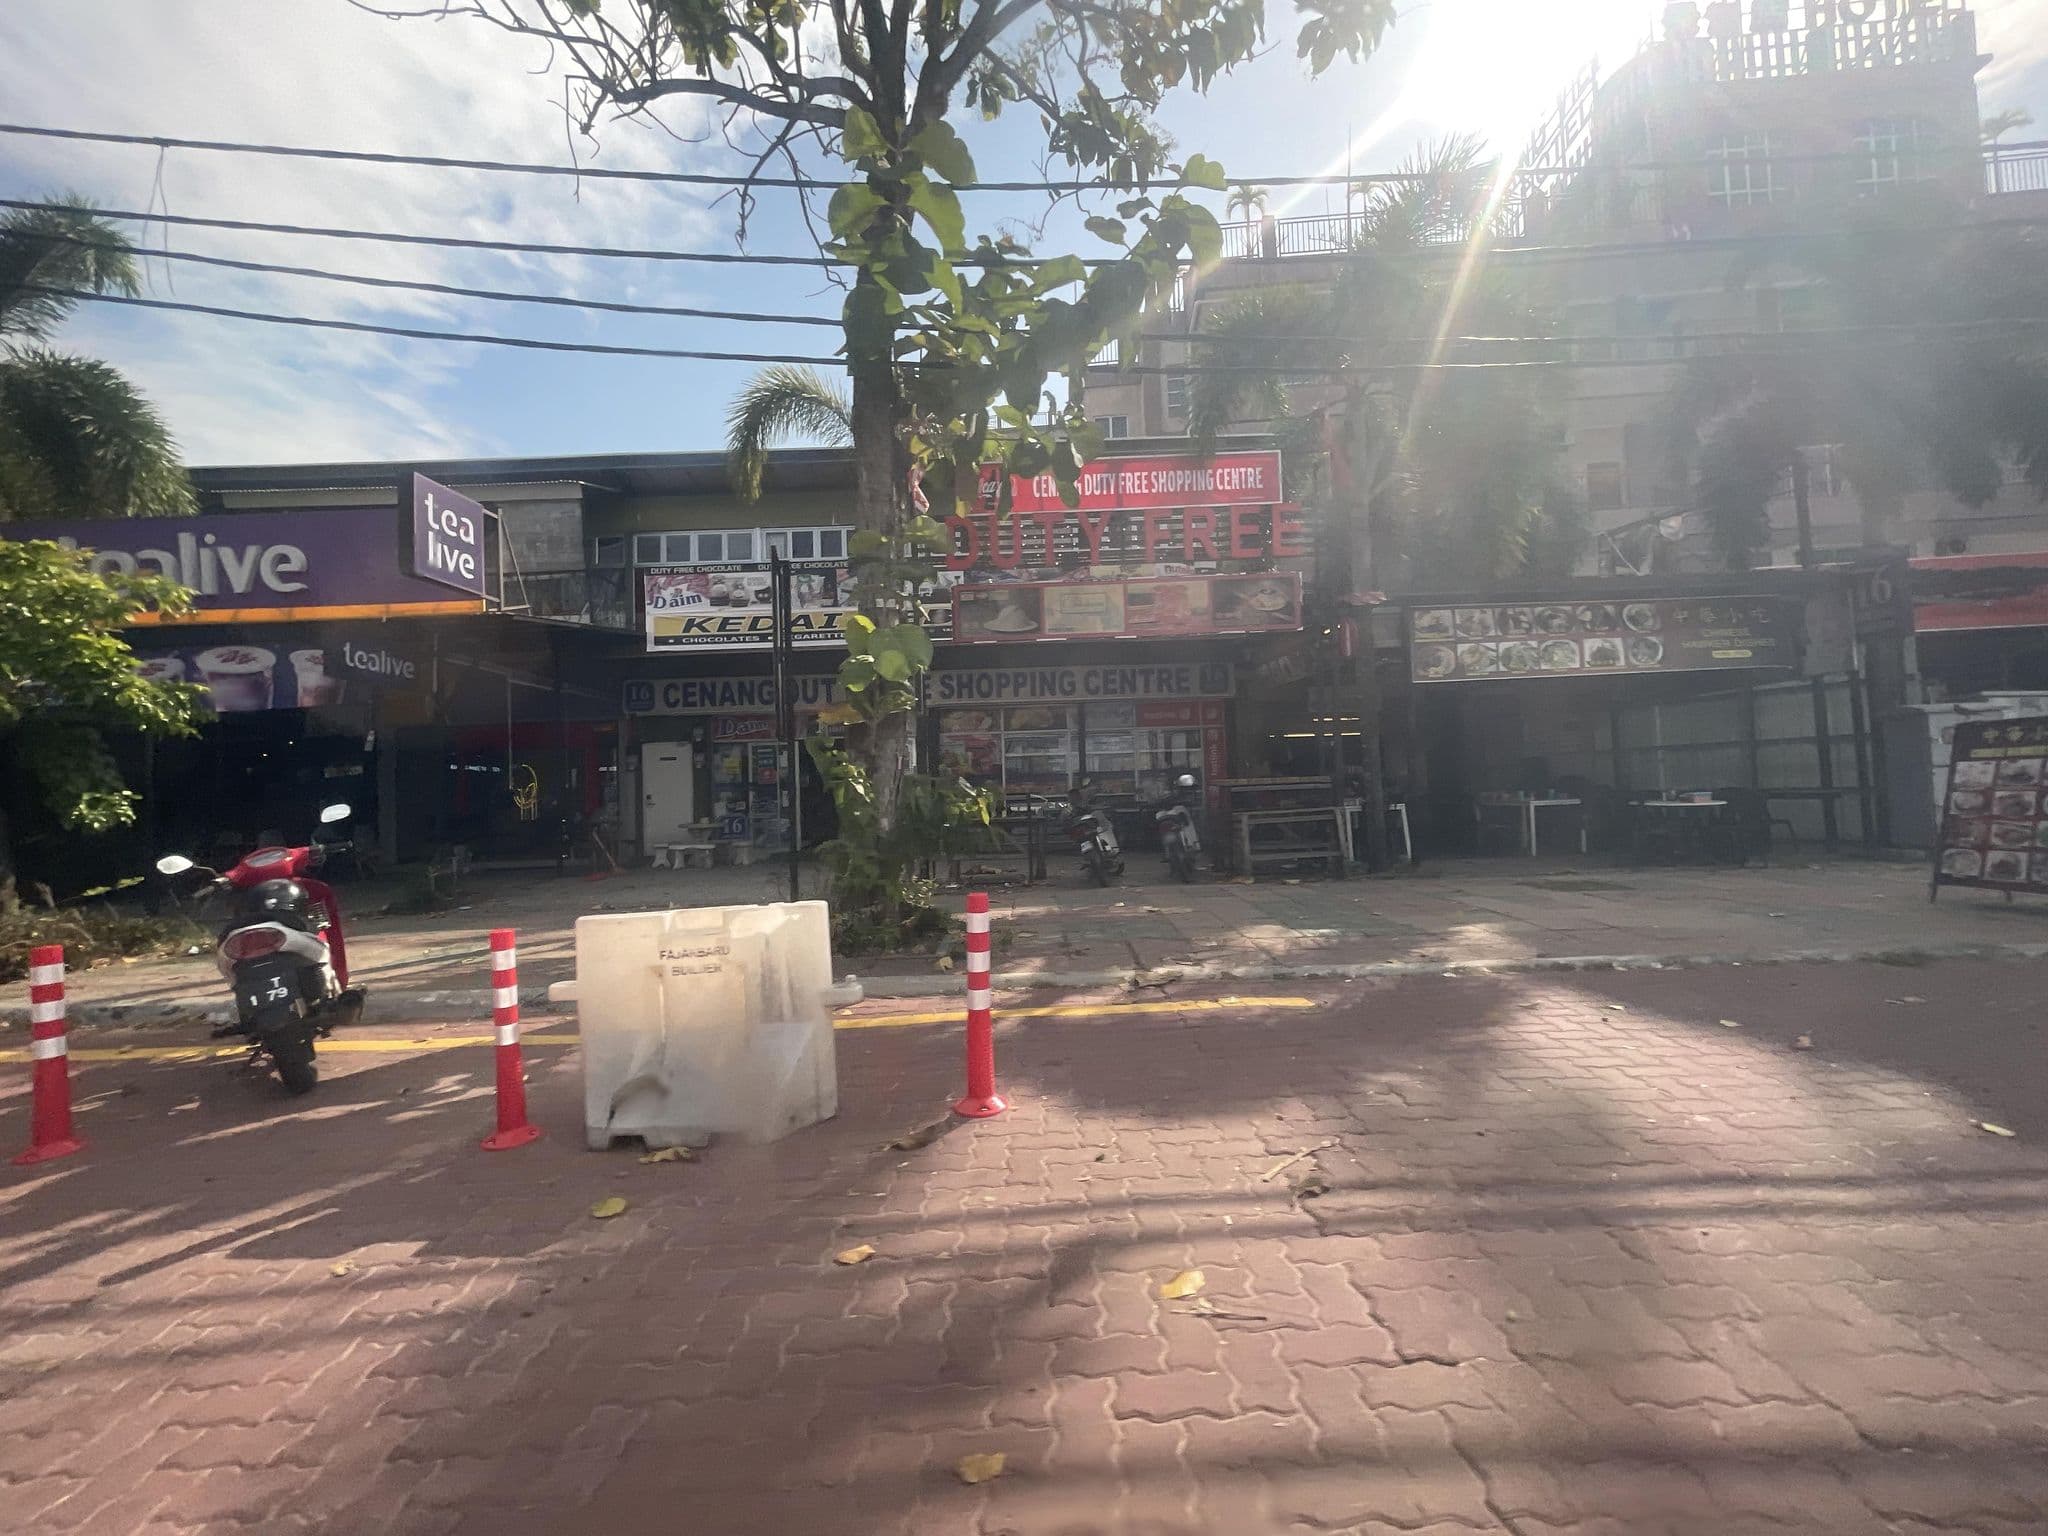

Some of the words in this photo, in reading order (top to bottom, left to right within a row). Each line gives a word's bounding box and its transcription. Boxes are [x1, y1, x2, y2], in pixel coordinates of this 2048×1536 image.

[1085, 472, 1115, 496] DUTY
[1119, 471, 1149, 495] FREE
[1151, 469, 1213, 493] SHOPPING
[1216, 466, 1264, 491] CENTRE
[424, 492, 475, 545] tea
[944, 511, 1113, 571] DUTY
[1143, 504, 1306, 563] FREE
[428, 531, 475, 580] live
[697, 565, 742, 573] CHOCOLATE
[653, 593, 704, 609] Daim
[682, 635, 760, 644] CHOCOLATES
[343, 641, 415, 679] tealive
[664, 680, 776, 709] CENANG
[939, 670, 1076, 699] SHOPPING
[1084, 666, 1191, 696] CENTRE
